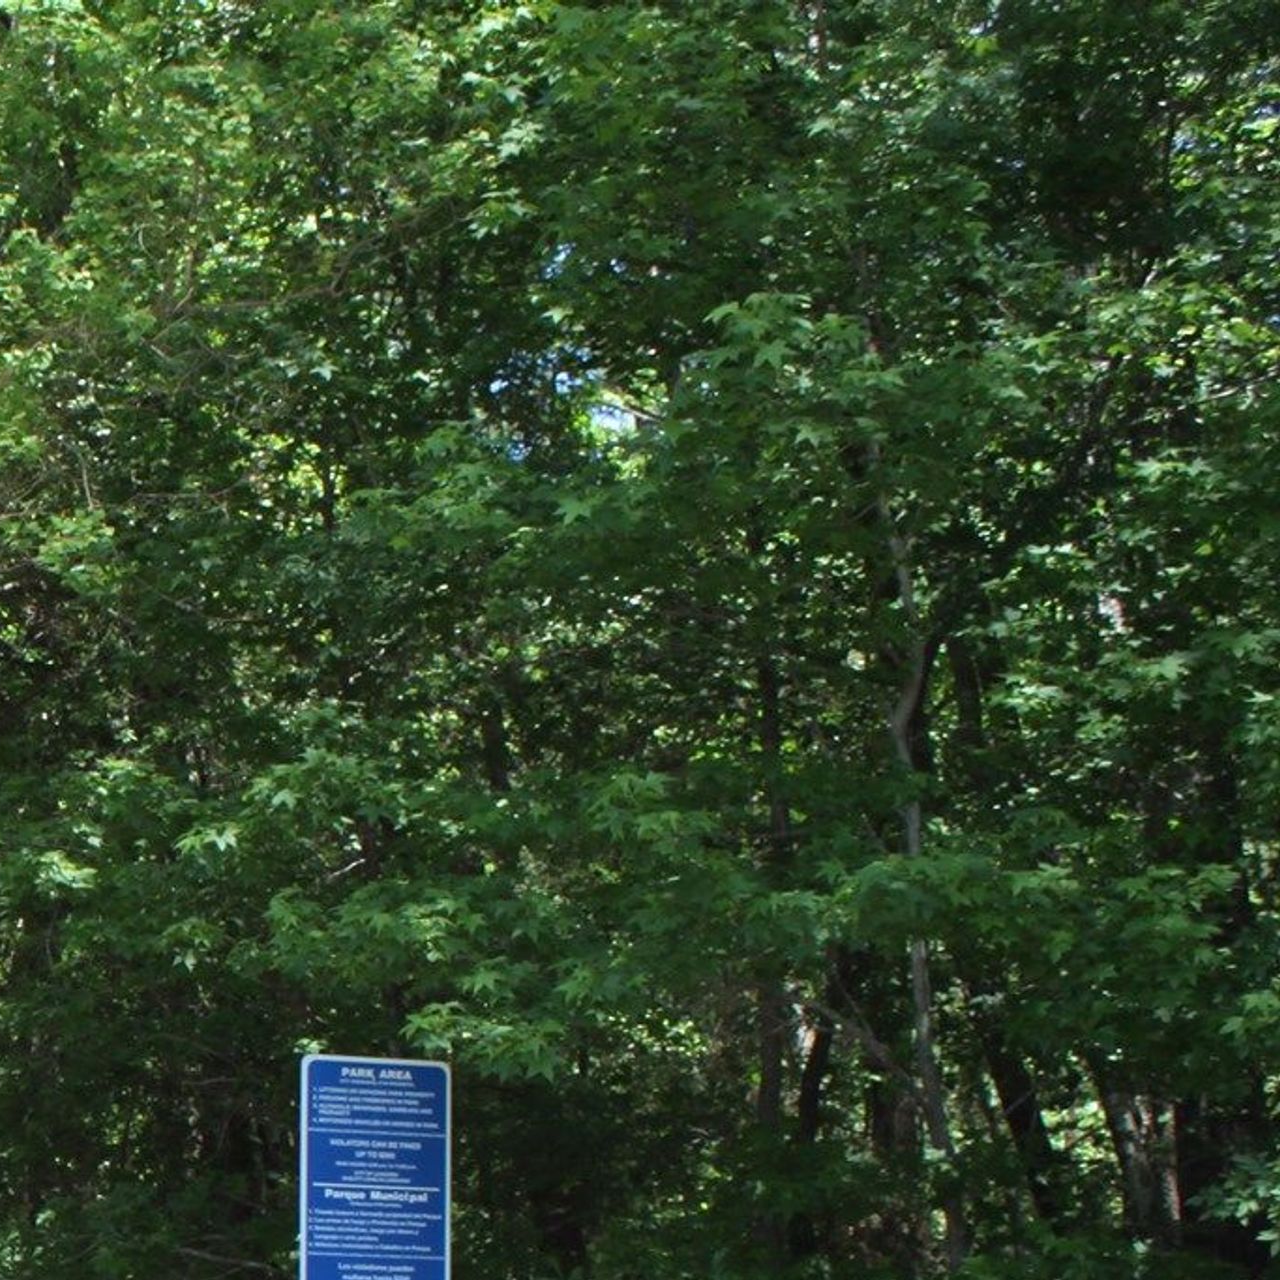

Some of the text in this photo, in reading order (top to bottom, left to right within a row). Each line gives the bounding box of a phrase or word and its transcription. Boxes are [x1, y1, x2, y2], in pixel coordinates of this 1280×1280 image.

[341, 1067, 412, 1080] PARK AREA
[324, 1188, 428, 1203] Parque Municipal
